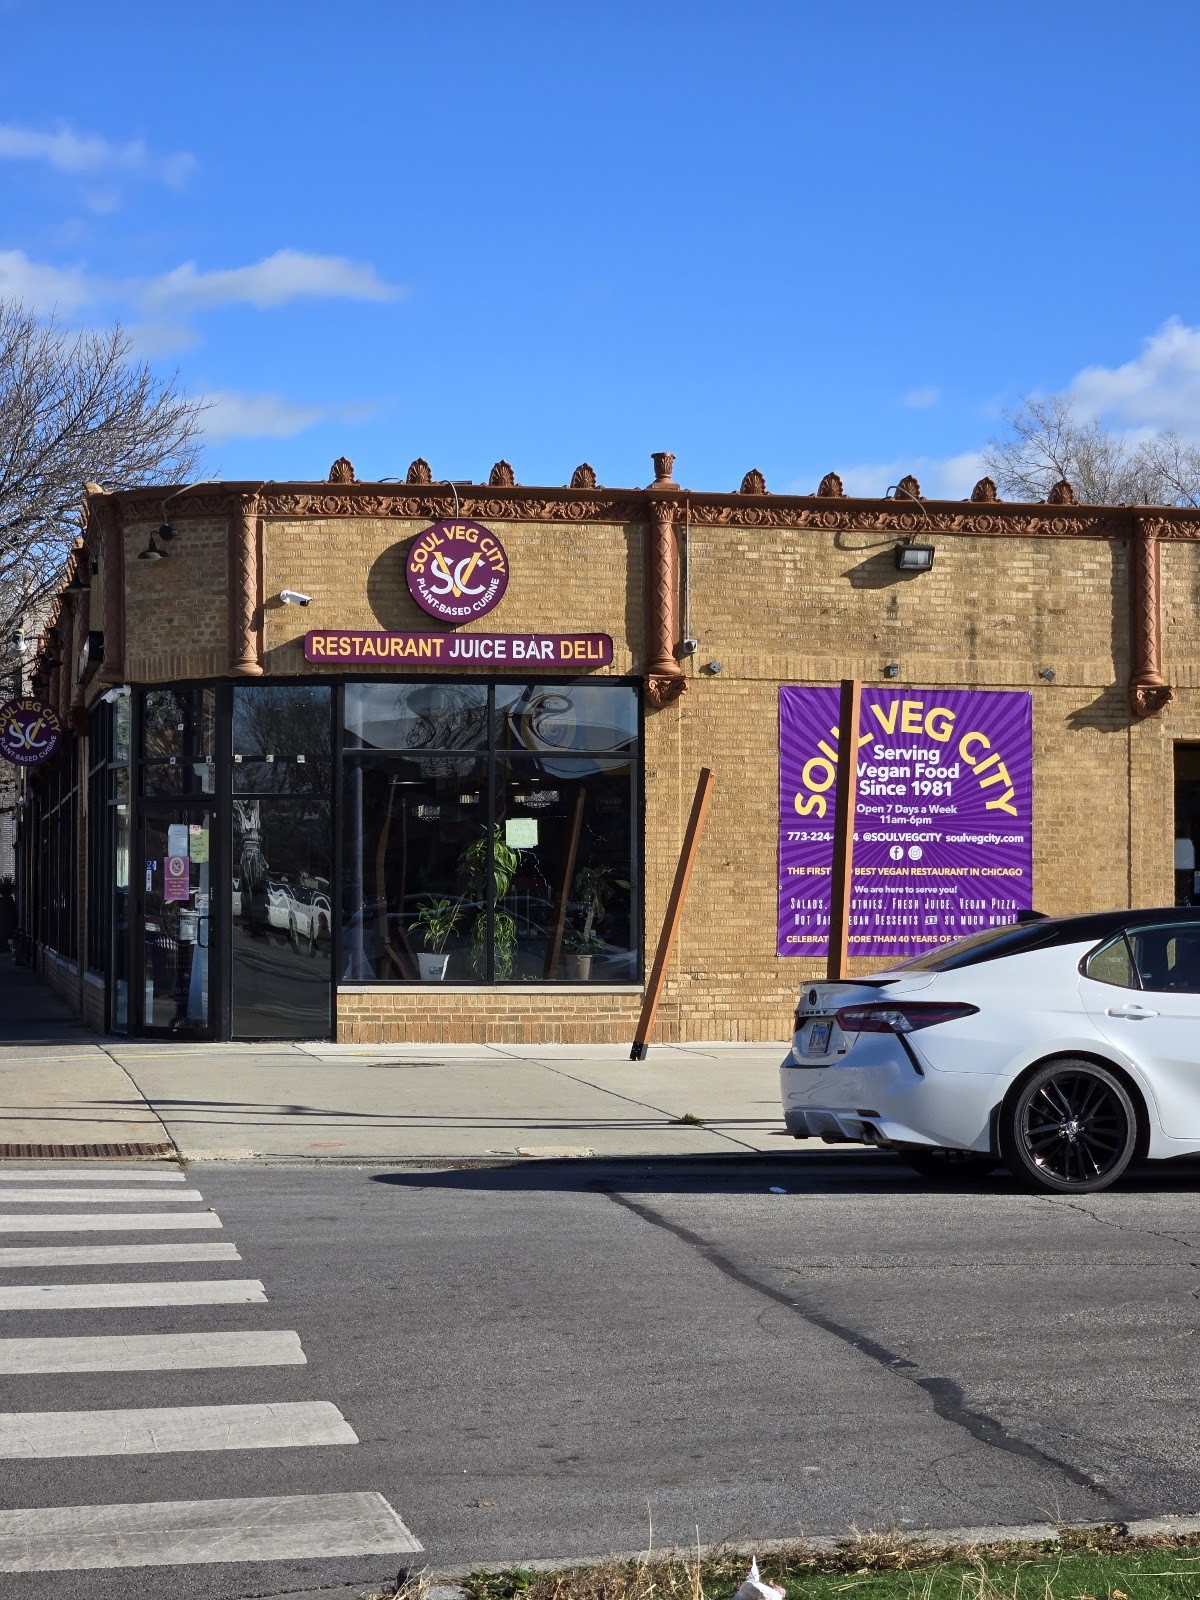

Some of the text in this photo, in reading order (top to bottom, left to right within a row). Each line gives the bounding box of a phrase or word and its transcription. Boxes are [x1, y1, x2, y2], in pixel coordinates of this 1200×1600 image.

[410, 525, 505, 574] SOUL VEG CITY
[416, 577, 500, 616] PLANT-BASED CUISINE
[312, 636, 604, 660] RESTAURANT JUICE BAR DELI
[16, 700, 42, 713] VEG
[42, 708, 61, 732] CITY
[38, 735, 57, 758] CUISINE
[873, 744, 940, 763] Serving
[870, 699, 957, 742] VEG
[958, 731, 1018, 817] CITY
[856, 762, 960, 782] Vegan Food
[859, 779, 952, 796] Since 1981
[856, 804, 958, 816] Open 7 Days a Week
[879, 815, 932, 827] 11am-6pm
[787, 831, 1024, 845] 773-224-4 @SOULVEGCITY soulvegcity.com
[787, 867, 805, 875] THE
[806, 867, 832, 875] FIRST
[854, 867, 876, 876] BEST
[877, 868, 909, 876] VEGAN
[910, 868, 968, 876] RESTAURANT
[970, 868, 980, 876] IN
[981, 868, 1023, 876] CHICAGO
[854, 885, 869, 893] We
[885, 885, 904, 894] here
[905, 886, 914, 894] to
[939, 885, 958, 896] you!
[848, 915, 869, 926] EGAN
[847, 935, 872, 943] MORE
[873, 935, 897, 943] THAN
[898, 935, 910, 943] 40
[910, 935, 938, 943] YEARS
[939, 935, 952, 943] OF
